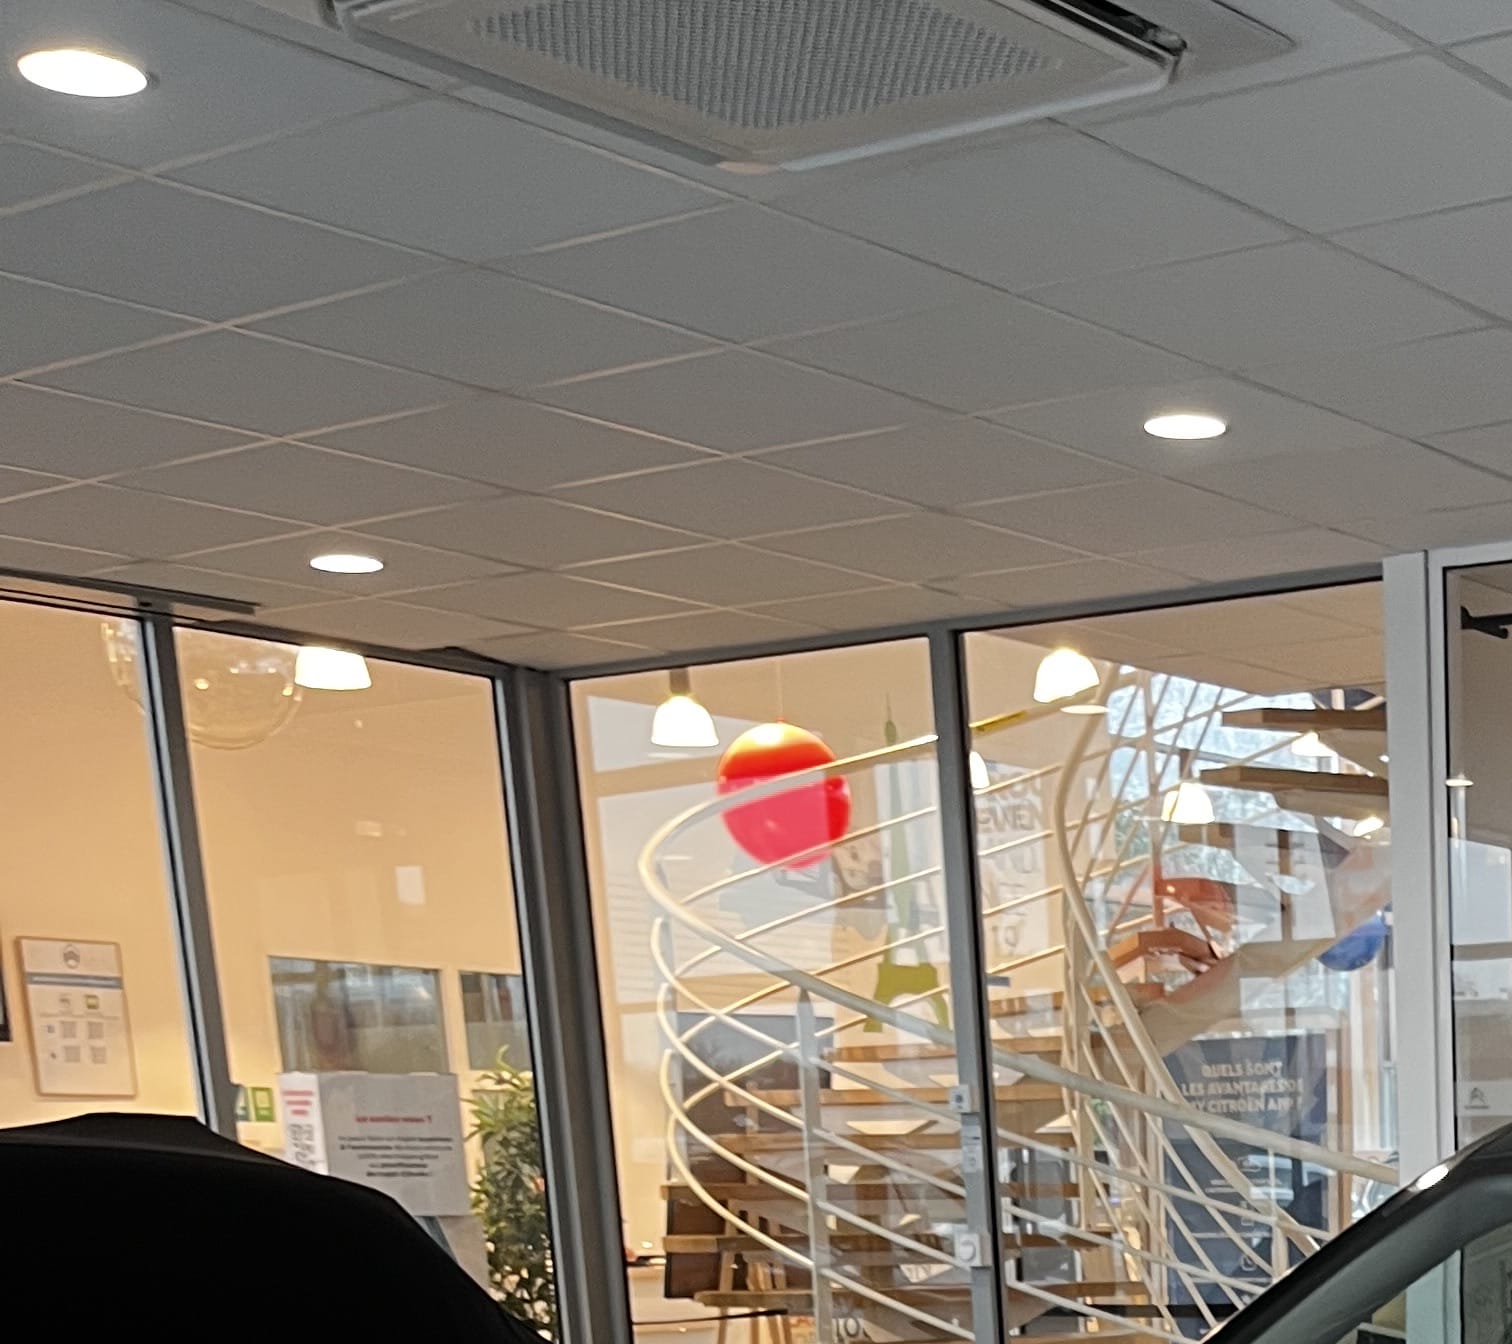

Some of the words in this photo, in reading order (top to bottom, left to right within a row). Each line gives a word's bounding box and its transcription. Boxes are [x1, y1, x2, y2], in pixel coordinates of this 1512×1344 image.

[1200, 1063, 1243, 1078] QUELS
[1245, 1060, 1284, 1077] SONT
[1181, 1082, 1205, 1097] LES
